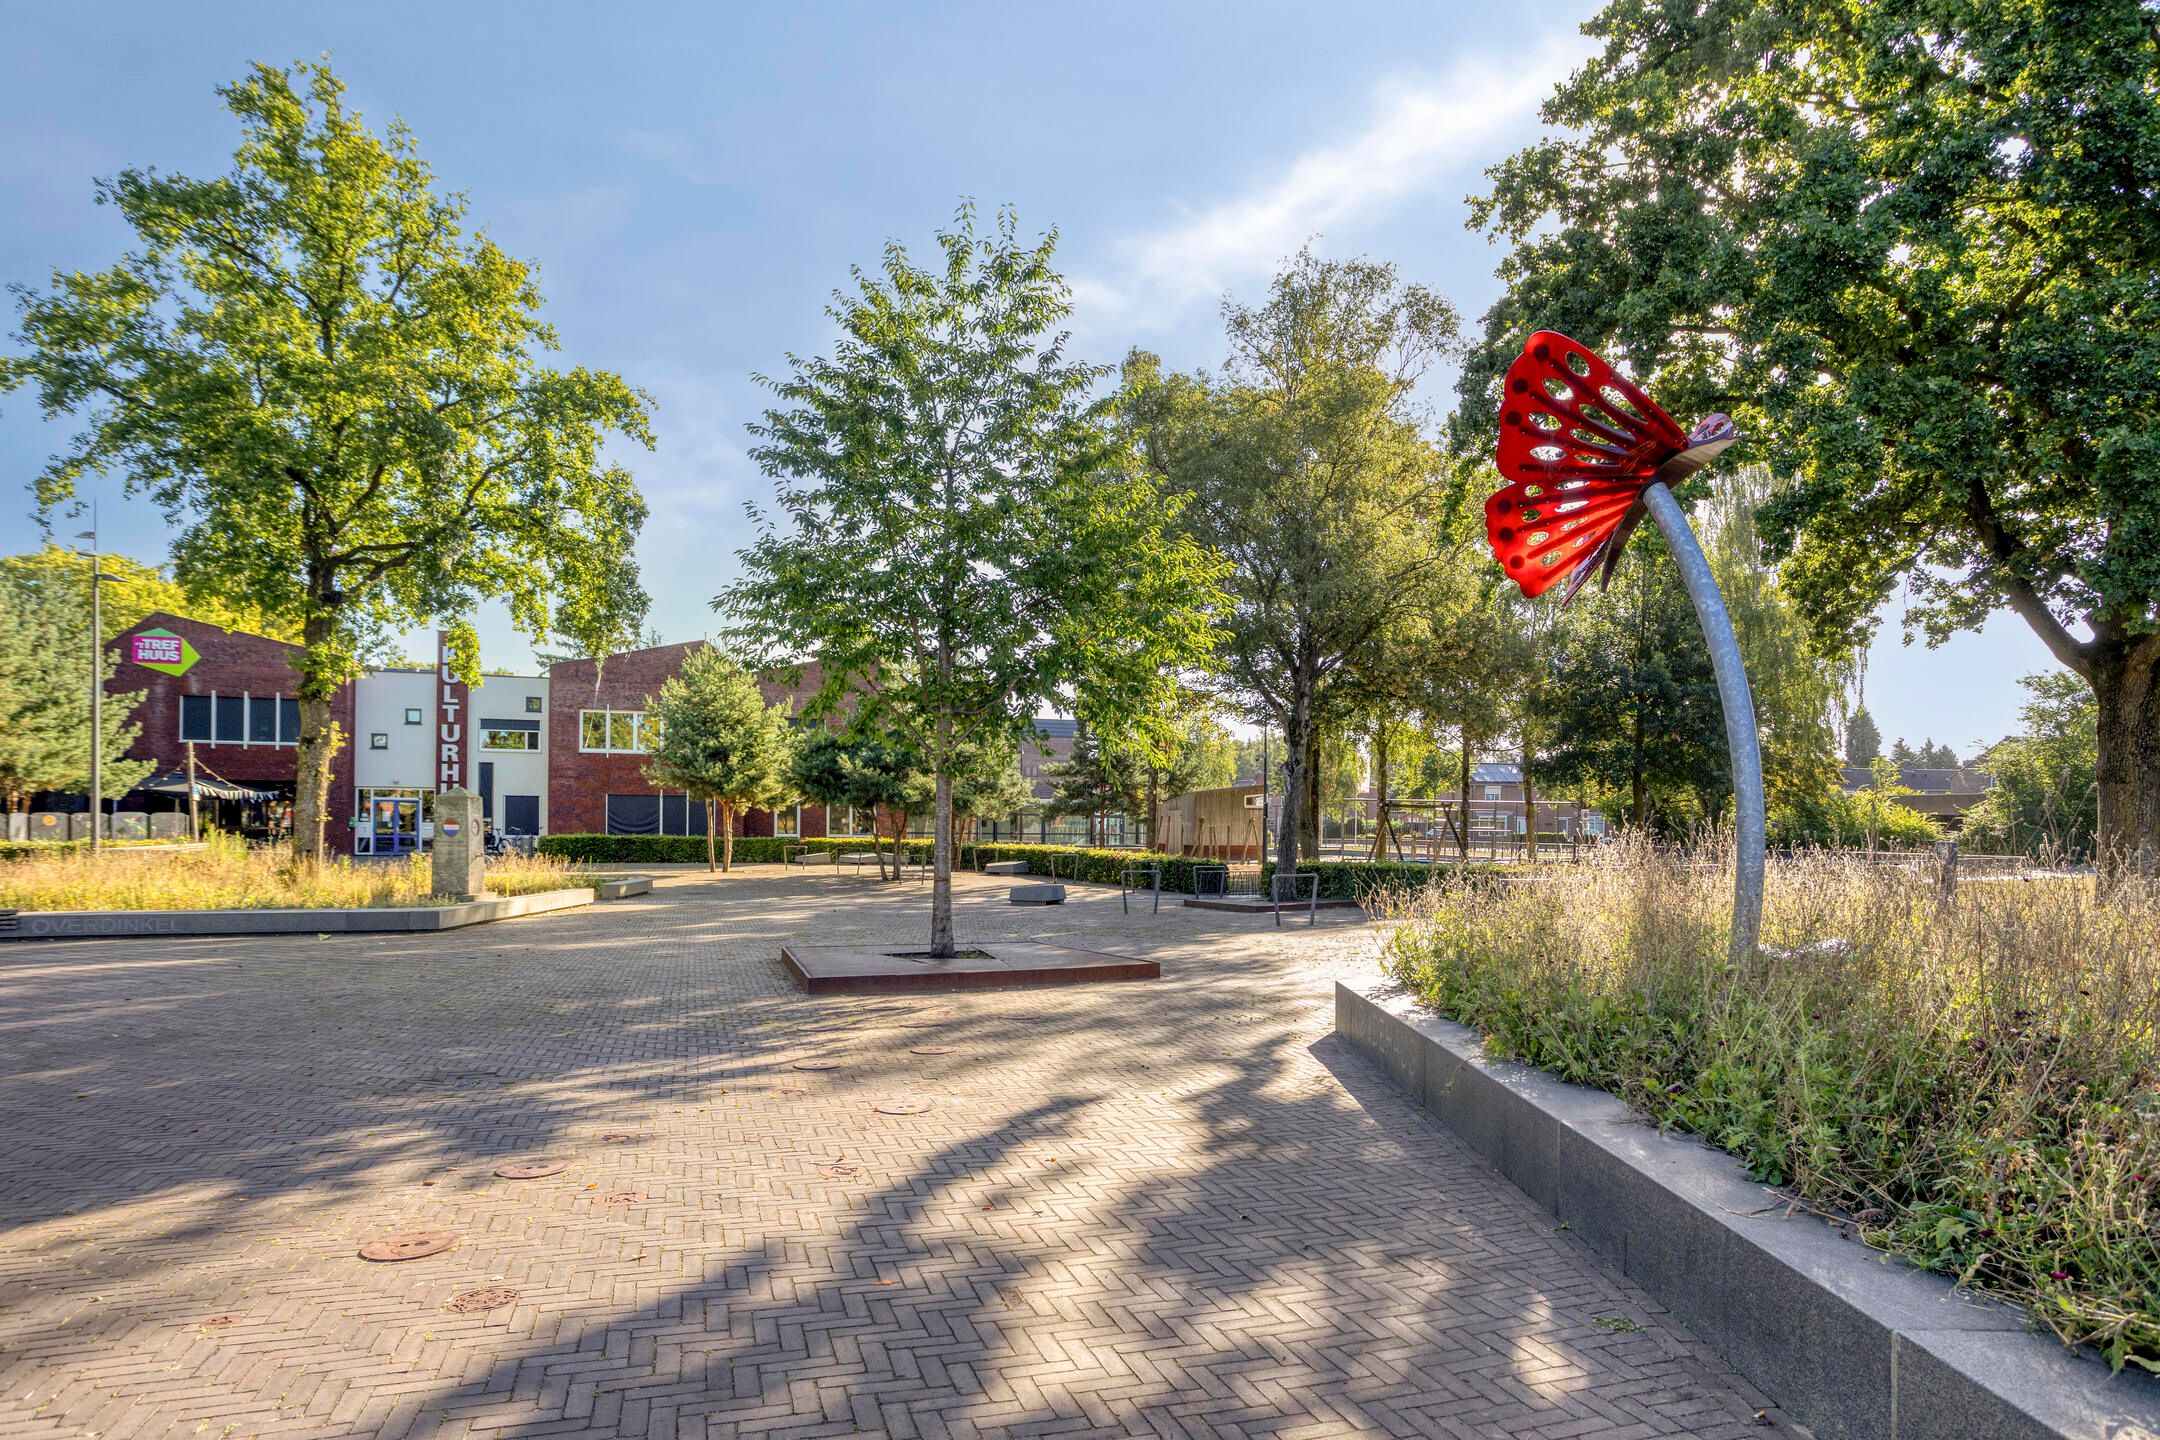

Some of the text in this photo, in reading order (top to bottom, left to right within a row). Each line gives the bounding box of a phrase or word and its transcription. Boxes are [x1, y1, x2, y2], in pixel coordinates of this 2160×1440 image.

[138, 649, 180, 661] HUUS
[440, 645, 461, 795] KULTURH
[31, 917, 182, 934] OVERDINKEL
